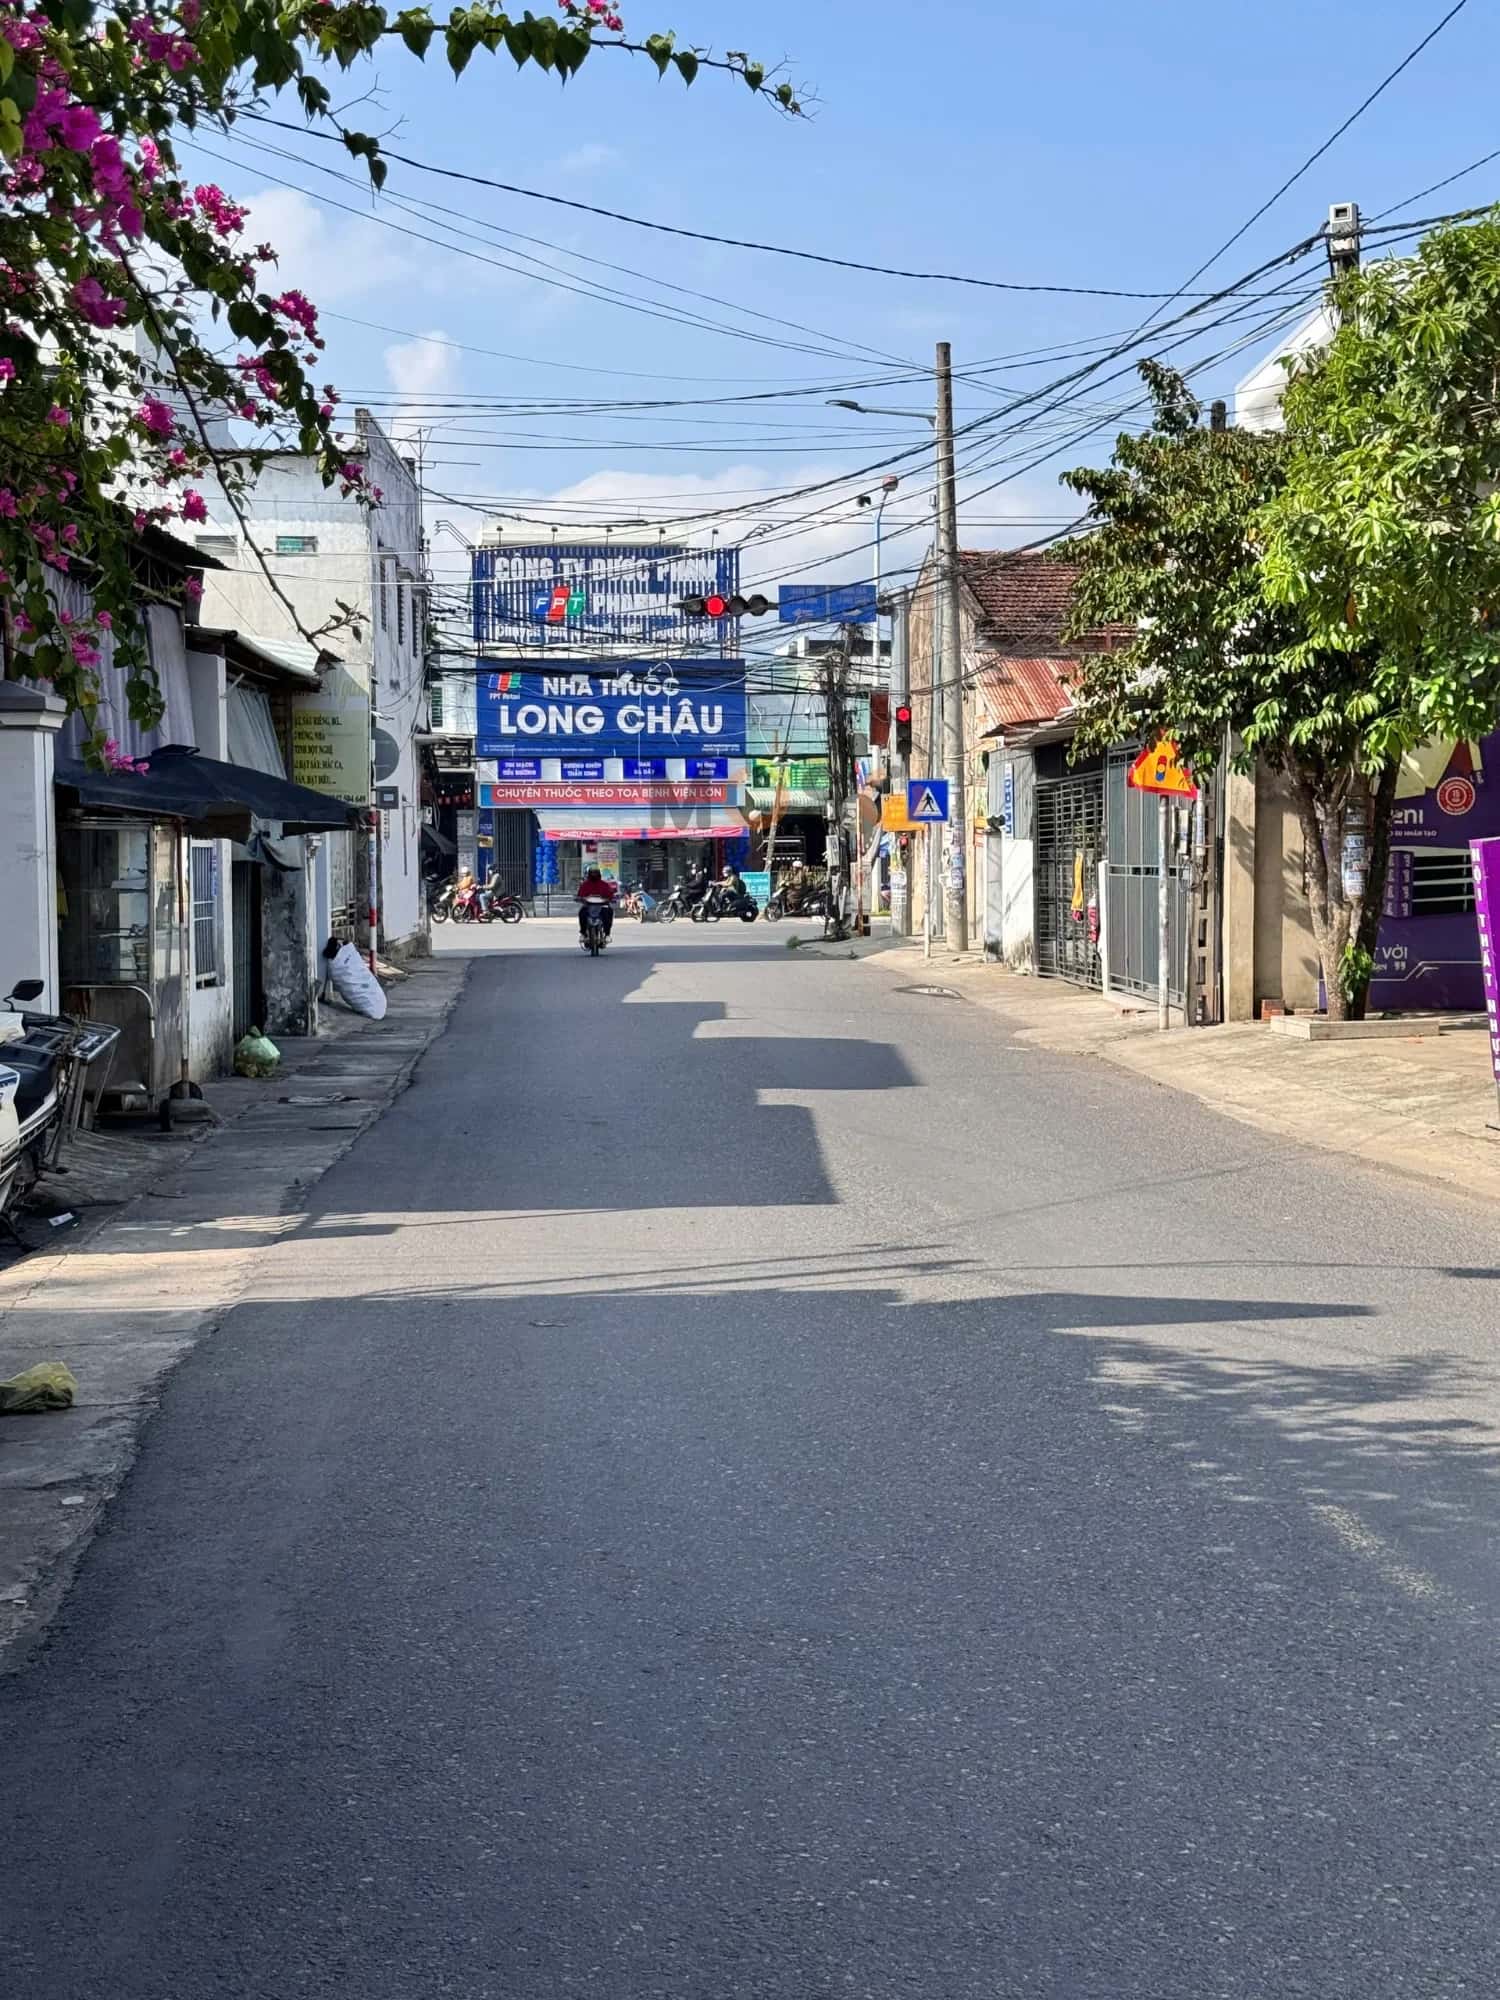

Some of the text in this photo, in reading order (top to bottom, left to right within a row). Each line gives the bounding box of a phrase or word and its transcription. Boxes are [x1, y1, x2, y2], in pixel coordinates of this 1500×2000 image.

[559, 558, 586, 580] TY
[500, 698, 723, 735] LONG CHÂU
[496, 786, 541, 798] CHUYÊN
[544, 785, 582, 798] THUỐC
[584, 788, 614, 798] THEO
[617, 788, 639, 798] TOA
